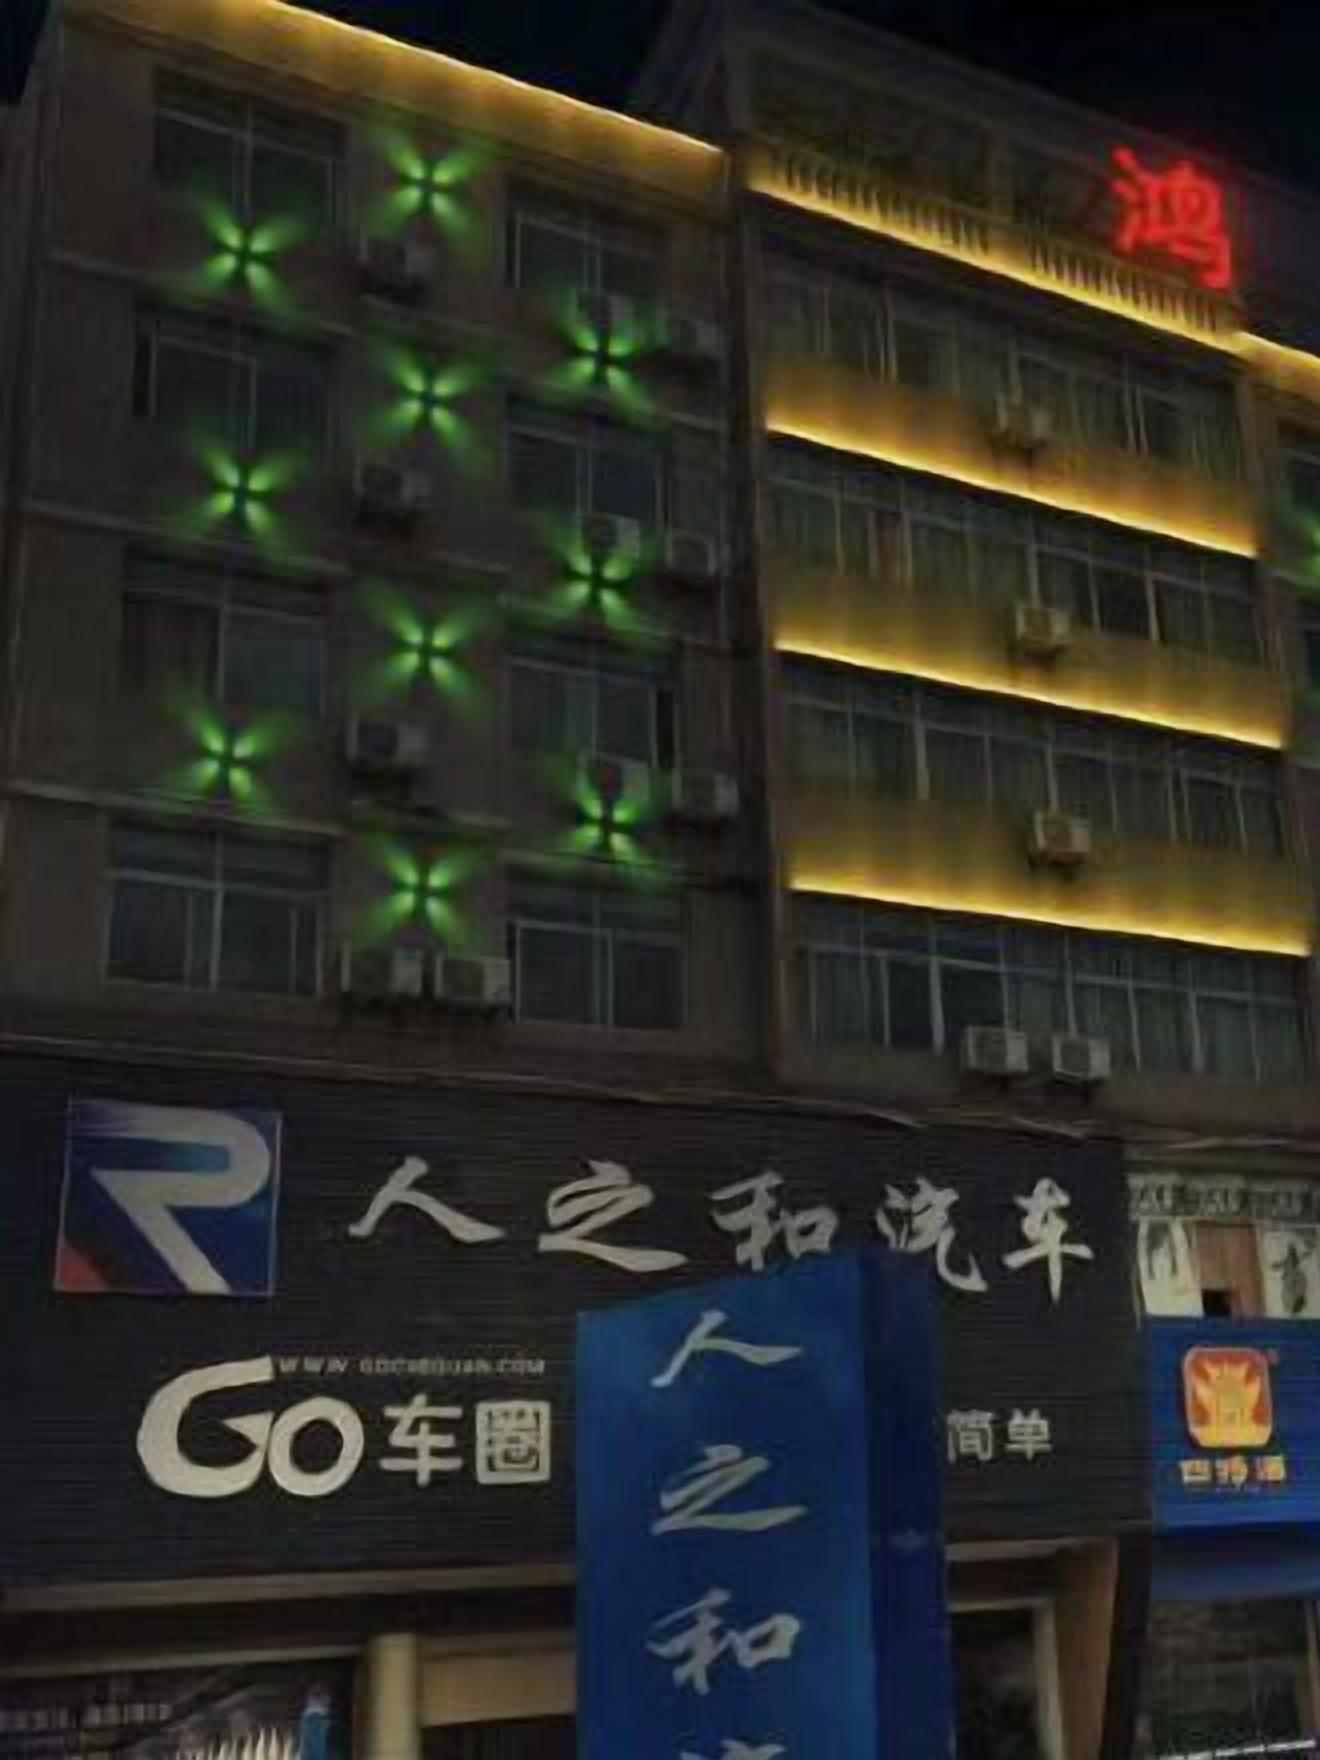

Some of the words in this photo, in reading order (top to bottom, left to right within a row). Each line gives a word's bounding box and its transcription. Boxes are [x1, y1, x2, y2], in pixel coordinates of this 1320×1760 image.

[348, 1157, 1093, 1302] 人之和汽车
[379, 1394, 551, 1484] 车圈
[946, 1408, 1052, 1463] 简单
[648, 1309, 807, 1760] 人之和
